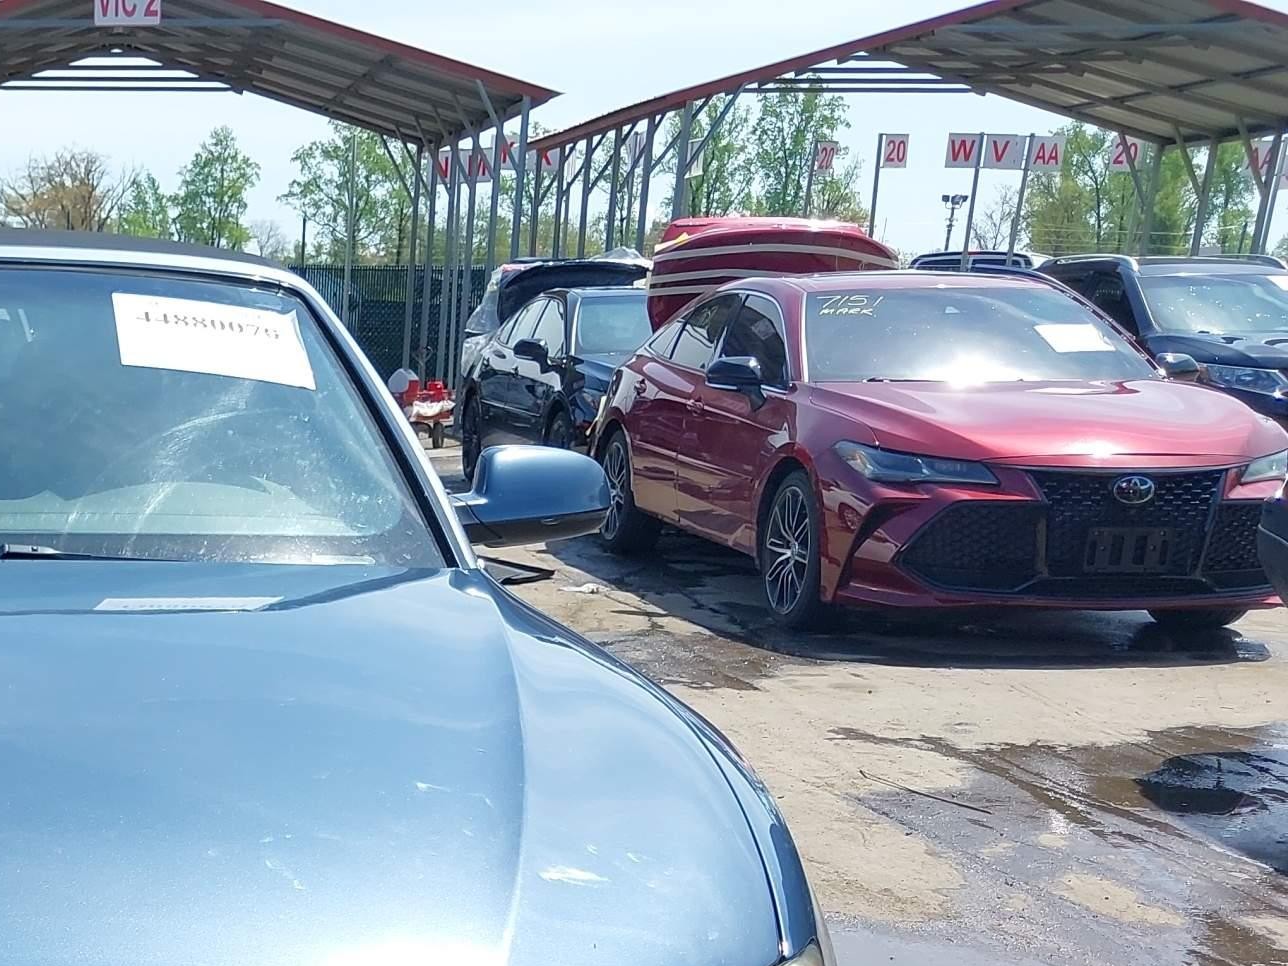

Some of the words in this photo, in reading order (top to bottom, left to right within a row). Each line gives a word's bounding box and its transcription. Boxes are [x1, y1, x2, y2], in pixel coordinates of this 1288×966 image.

[99, 0, 137, 17] VIC
[144, 0, 159, 17] 2
[816, 146, 836, 170] 20
[884, 139, 907, 163] 20
[950, 139, 976, 162] W
[992, 139, 1011, 163] V
[1033, 142, 1060, 166] AA
[1112, 142, 1139, 166] 20
[816, 294, 885, 308] 7151
